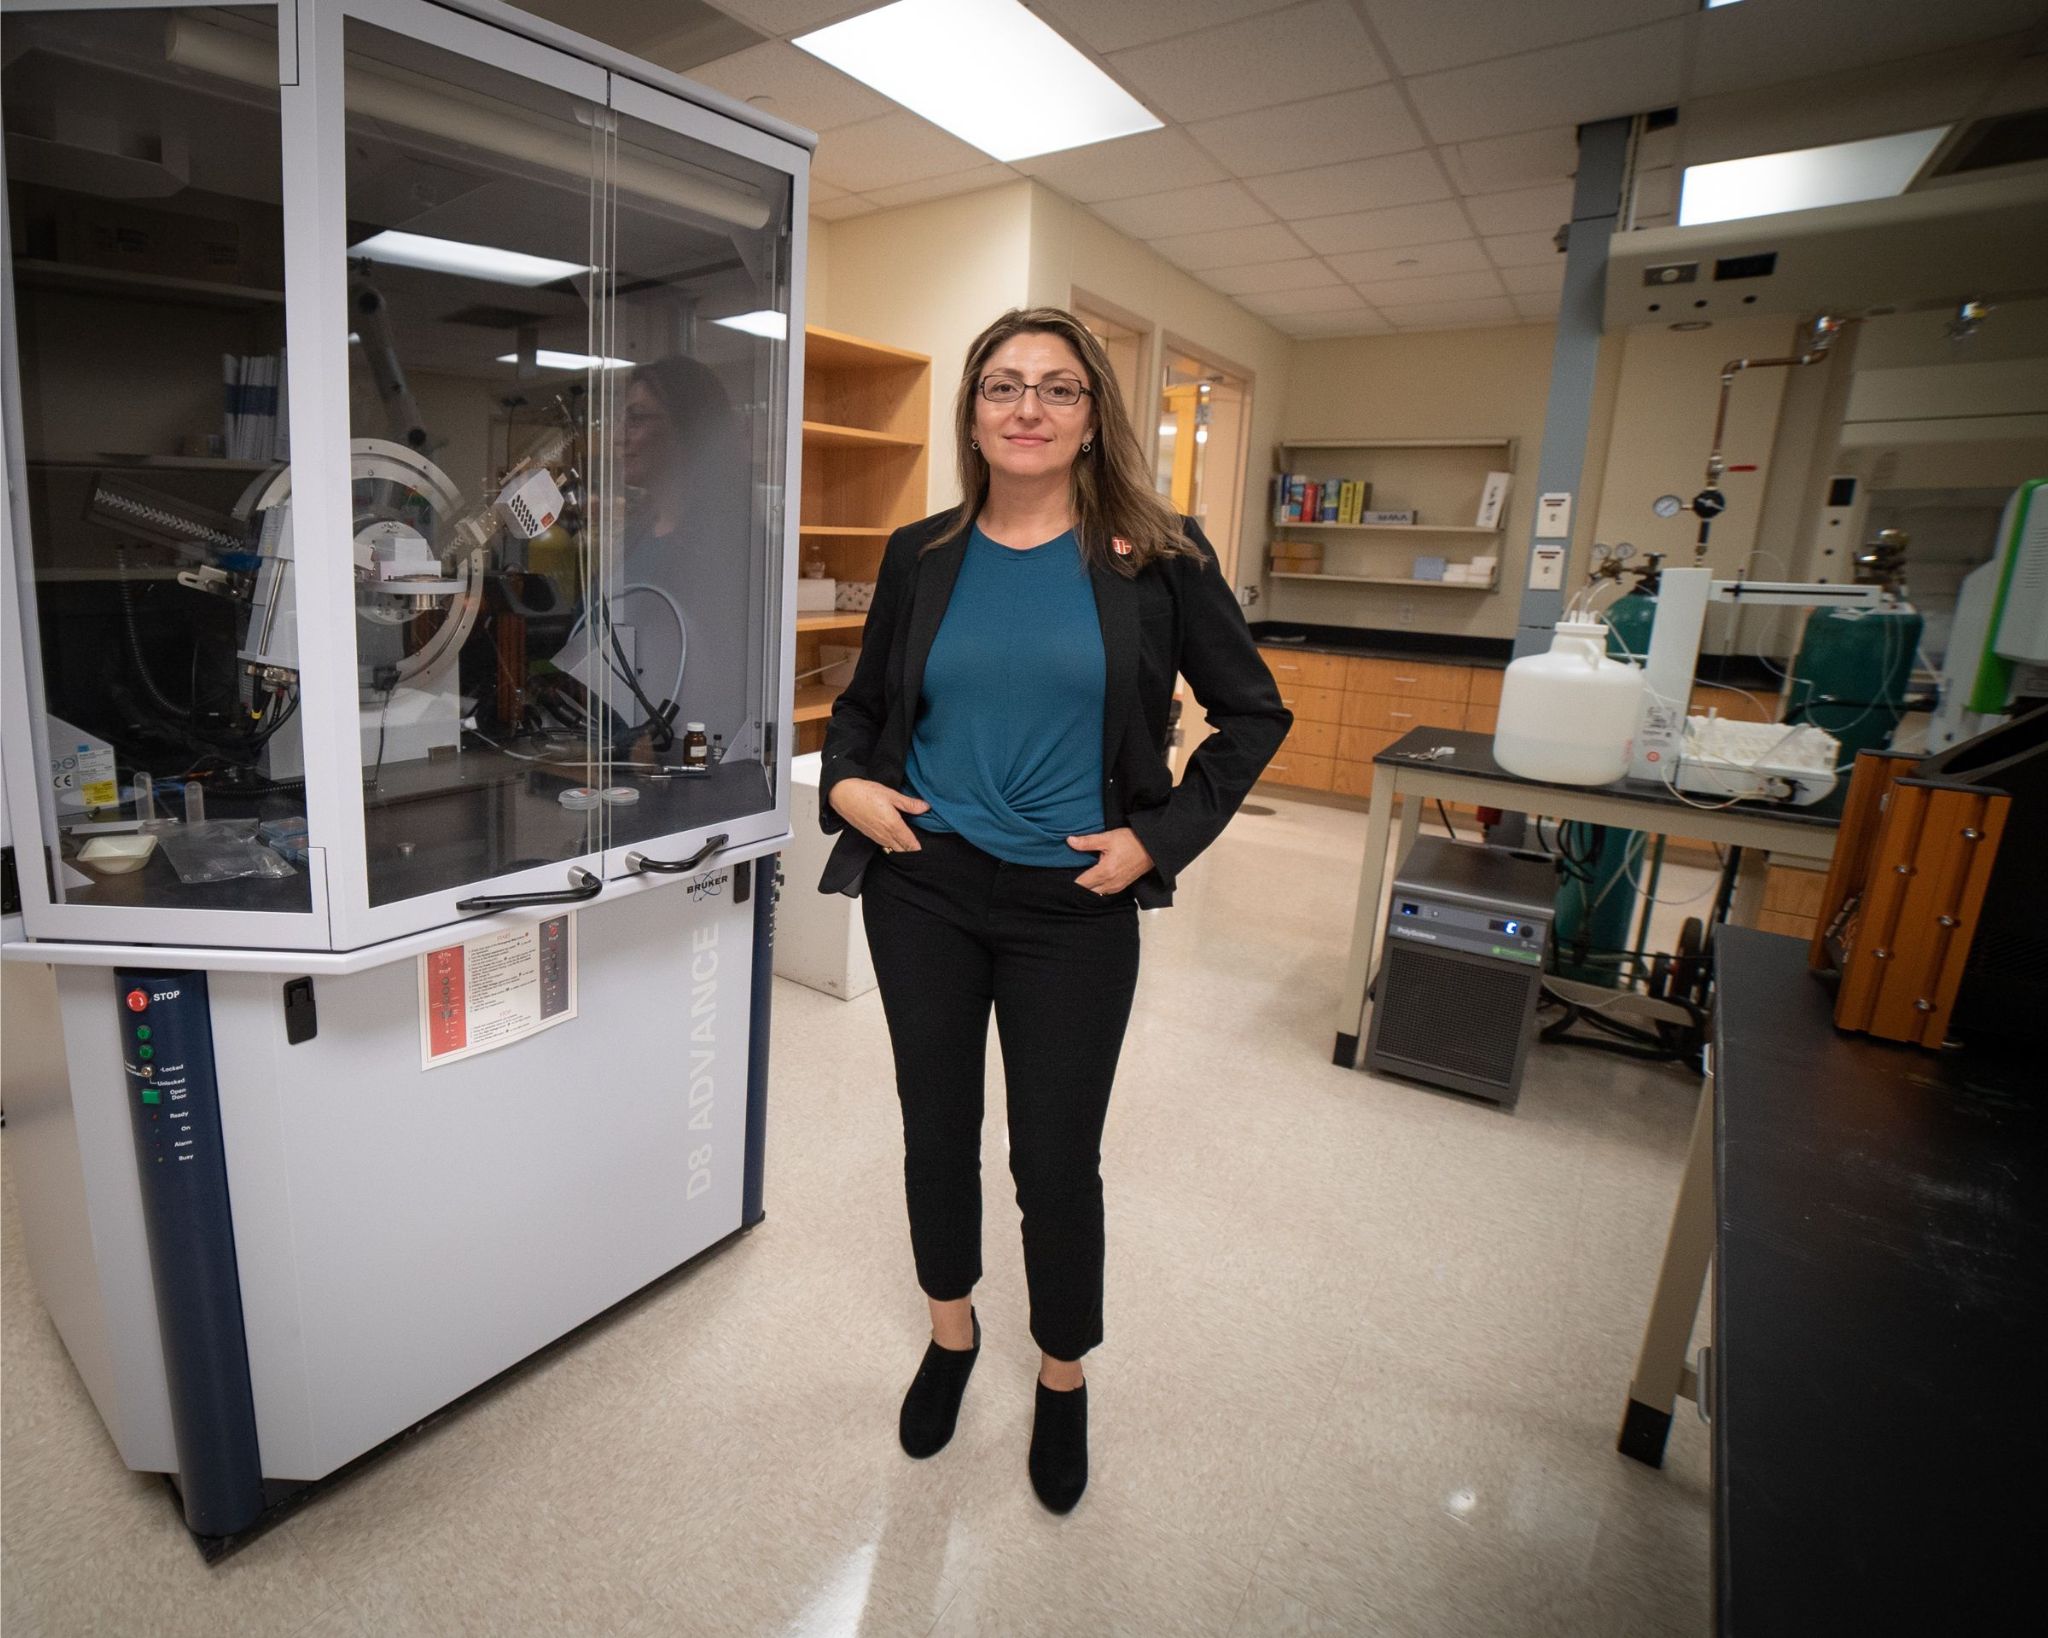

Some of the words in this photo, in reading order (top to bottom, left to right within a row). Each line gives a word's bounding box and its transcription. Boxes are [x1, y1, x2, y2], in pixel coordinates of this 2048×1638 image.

[686, 875, 728, 894] BRUKER
[153, 990, 180, 1001] STOP
[687, 922, 721, 1133] ADVANCE
[161, 1064, 184, 1073] Locked
[157, 1077, 186, 1087] Unlocked
[169, 1087, 187, 1096] Open
[171, 1093, 187, 1101] Door
[169, 1111, 189, 1119] Ready
[174, 1139, 193, 1148] Alarm
[178, 1153, 194, 1162] Busy
[686, 1142, 713, 1201] D8
